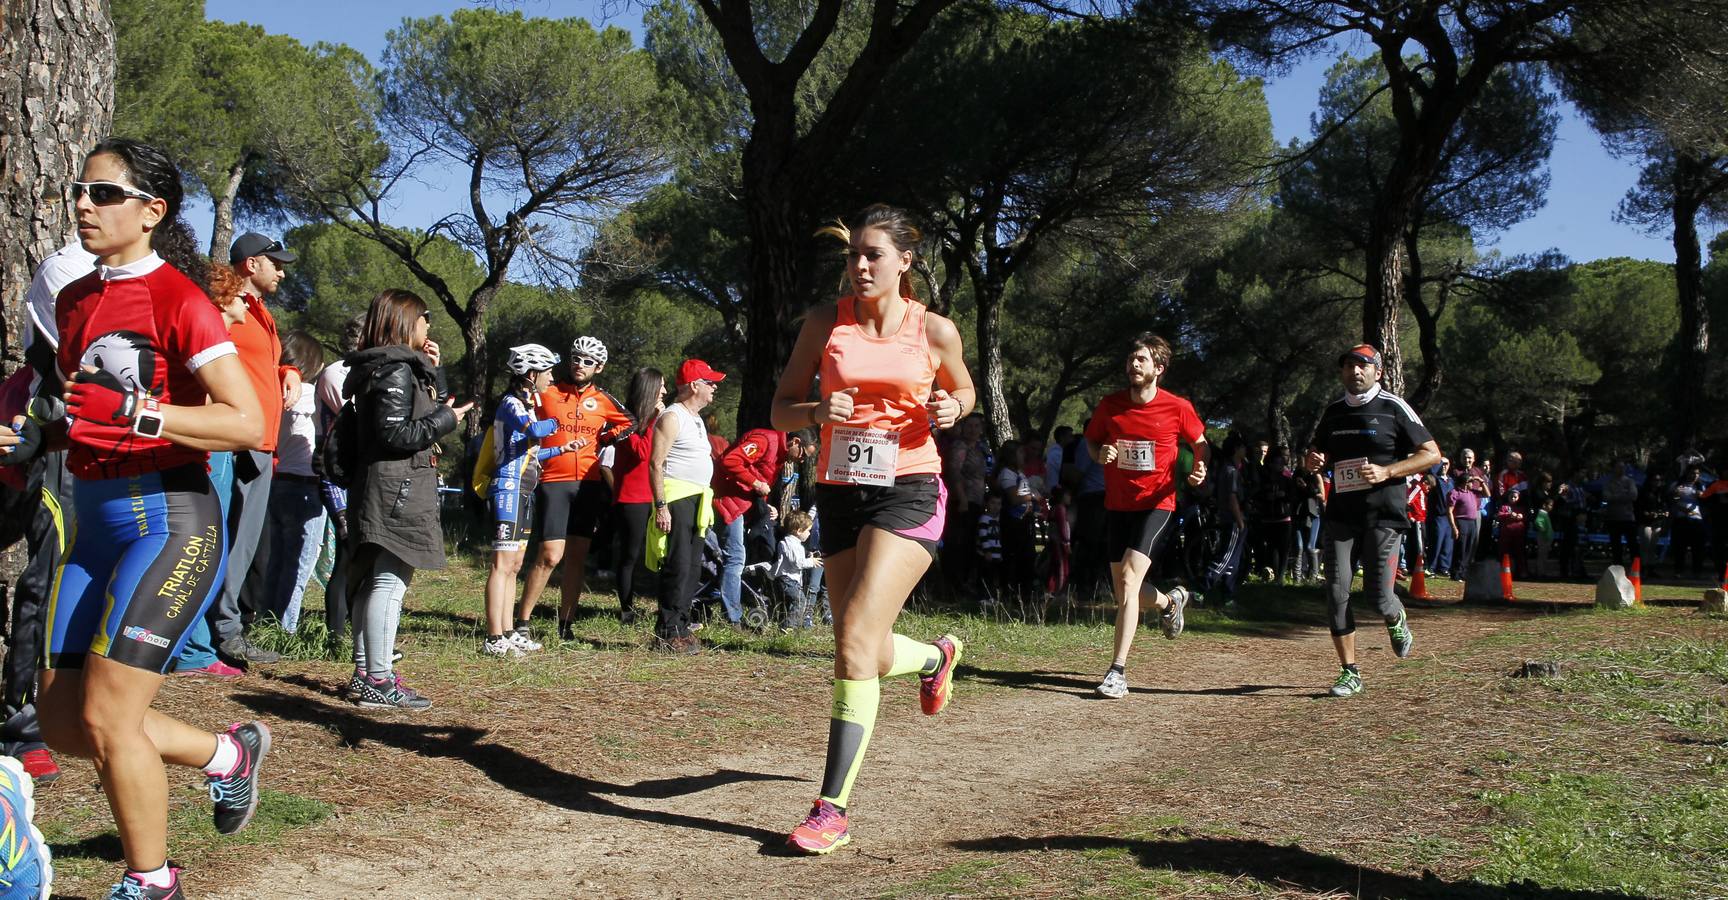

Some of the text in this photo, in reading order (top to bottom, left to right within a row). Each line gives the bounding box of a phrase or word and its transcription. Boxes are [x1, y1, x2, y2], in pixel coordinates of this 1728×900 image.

[848, 444, 873, 464] 91
[1124, 448, 1147, 460] 131
[833, 468, 887, 480] dorsalia.com
[157, 535, 205, 598] TRIATLÓN
[166, 524, 218, 619] CANAL DE CASTILLA
